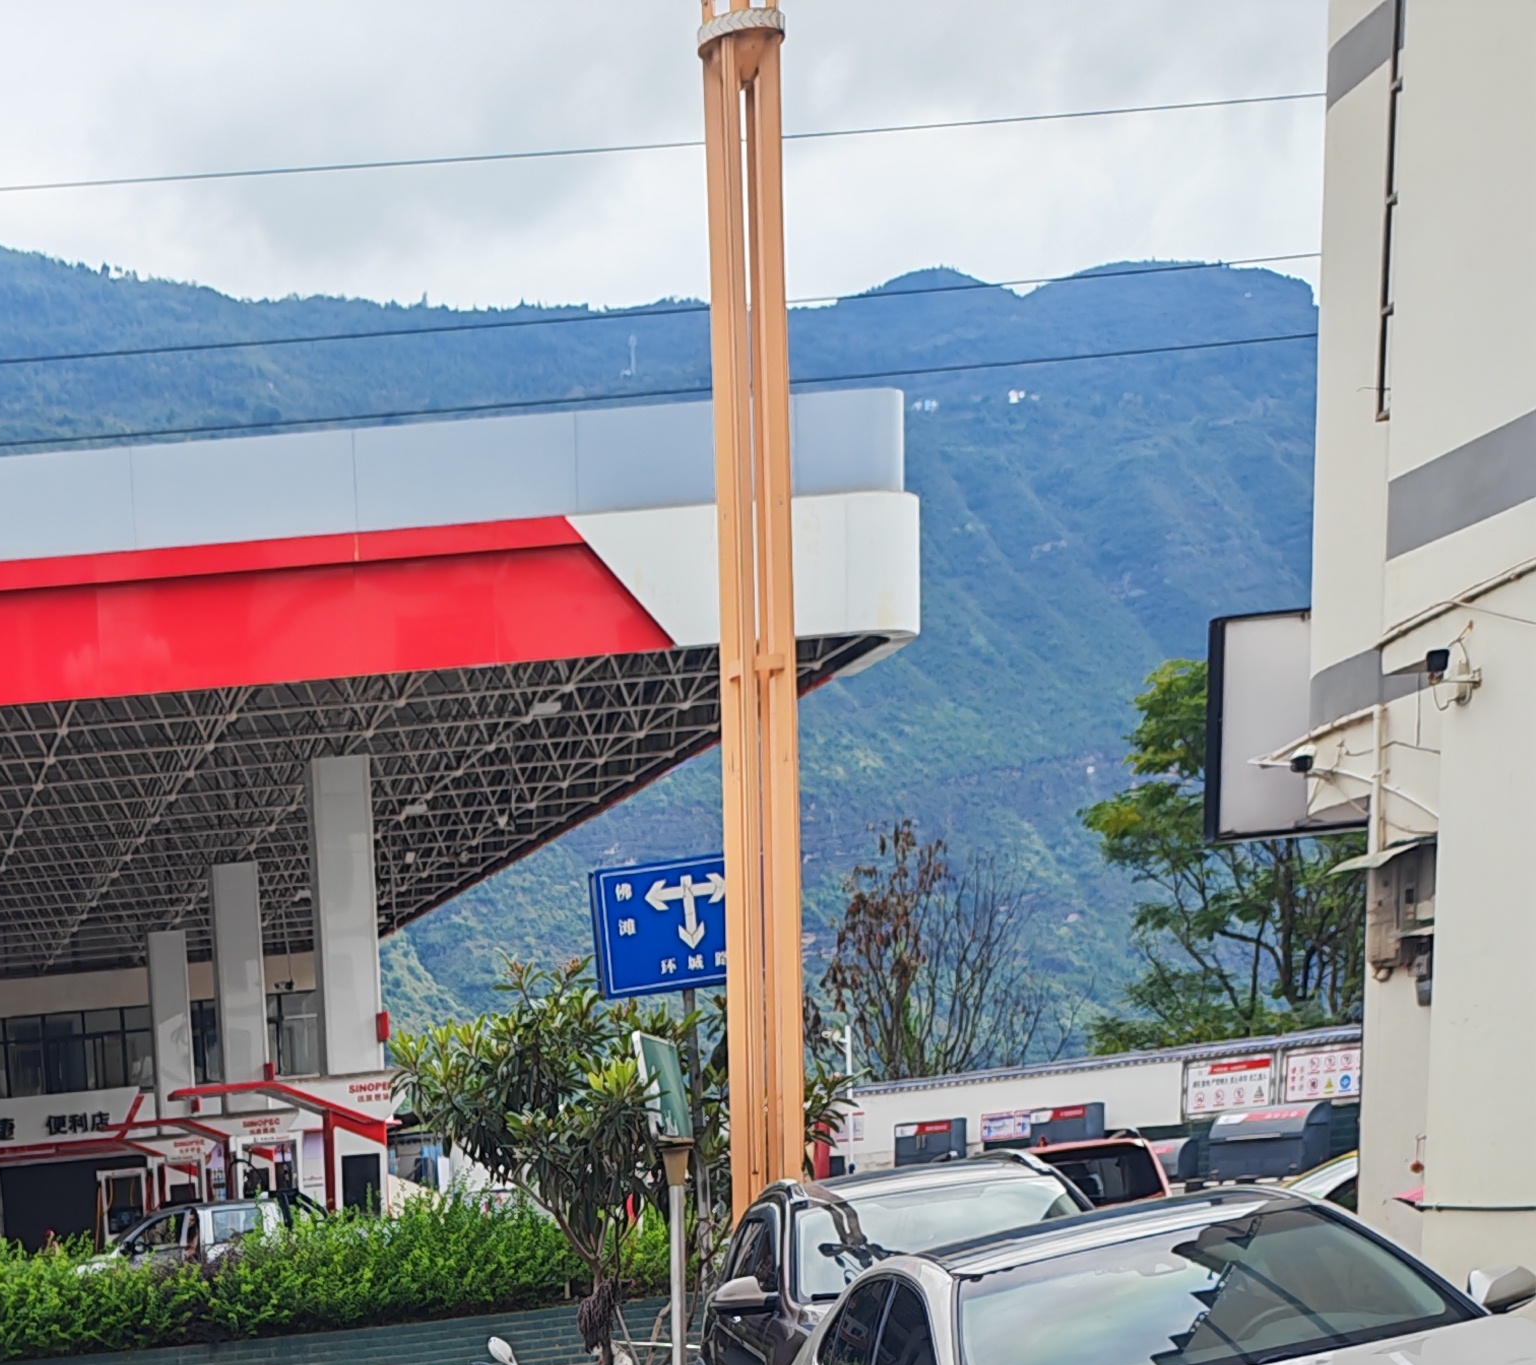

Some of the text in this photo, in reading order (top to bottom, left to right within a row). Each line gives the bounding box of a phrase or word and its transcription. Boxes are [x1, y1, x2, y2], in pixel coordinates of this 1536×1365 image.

[348, 1081, 393, 1094] SINOPE
[45, 1110, 110, 1136] 便利店
[242, 1117, 281, 1129] SINOPEC
